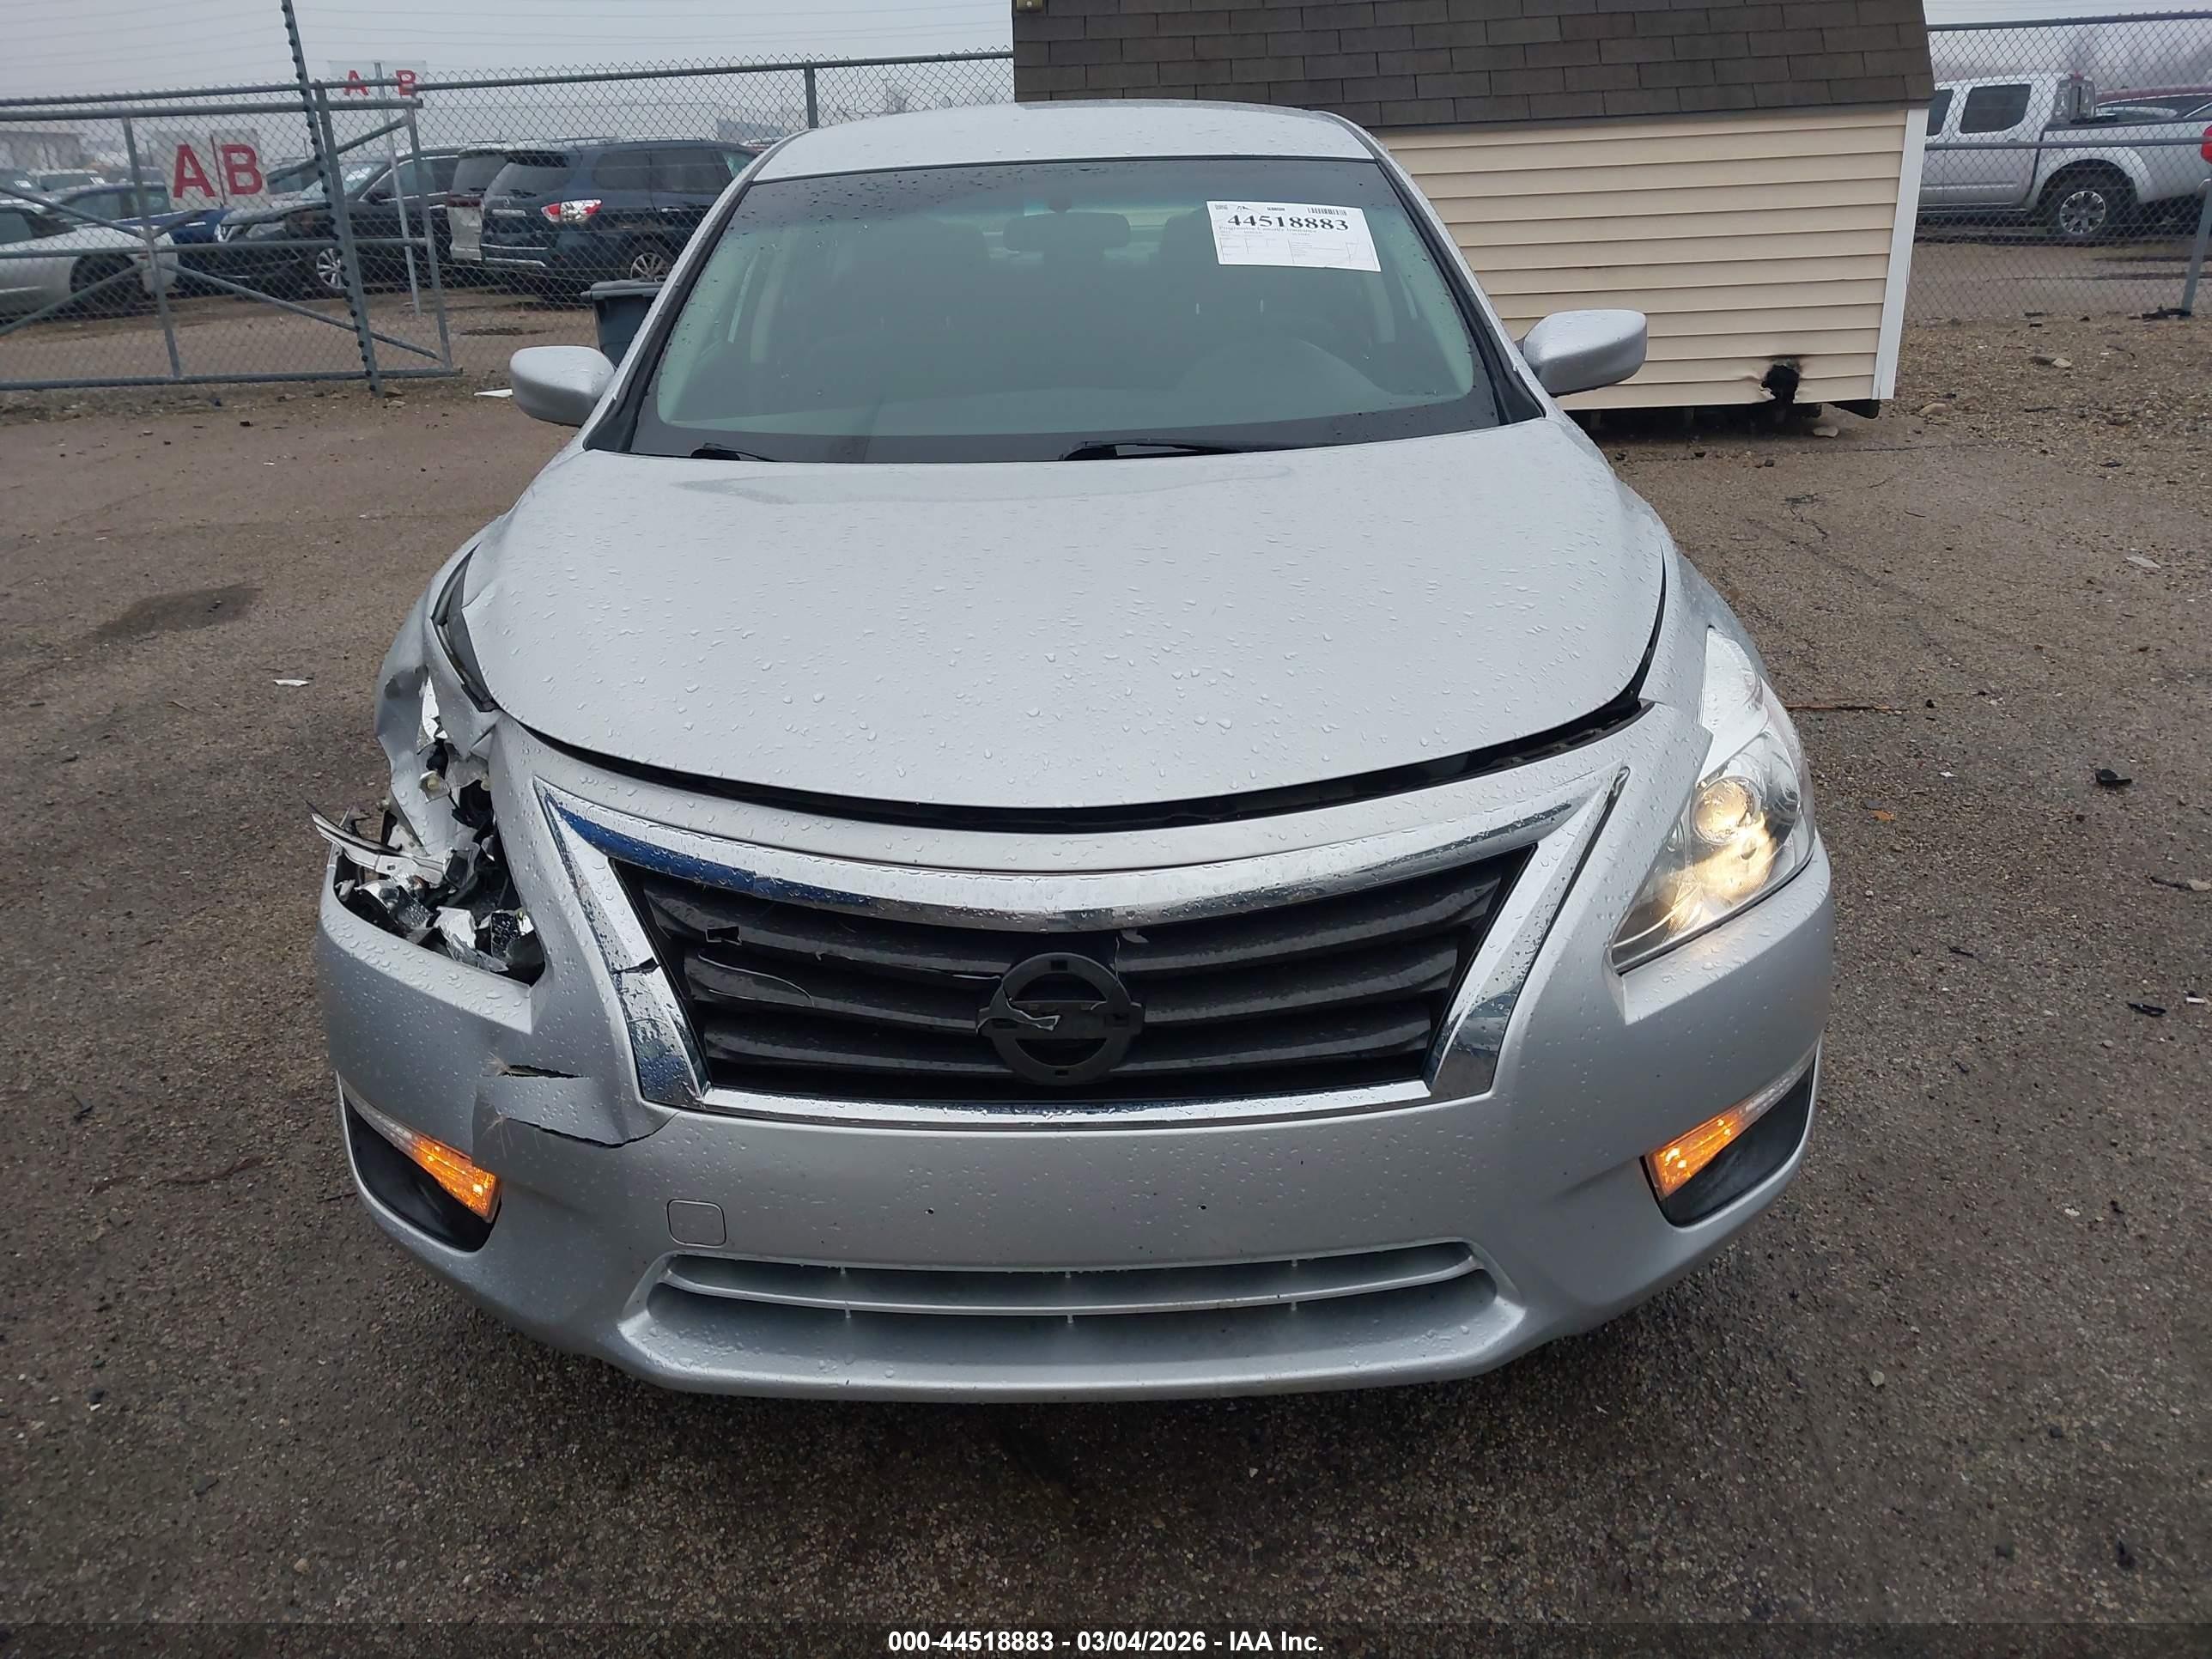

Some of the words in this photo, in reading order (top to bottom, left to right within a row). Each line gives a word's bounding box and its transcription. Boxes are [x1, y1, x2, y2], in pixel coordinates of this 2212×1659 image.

[344, 70, 369, 95] A
[396, 70, 416, 95] B
[173, 144, 216, 198] A
[221, 144, 263, 196] B
[1227, 215, 1348, 231] 44518883
